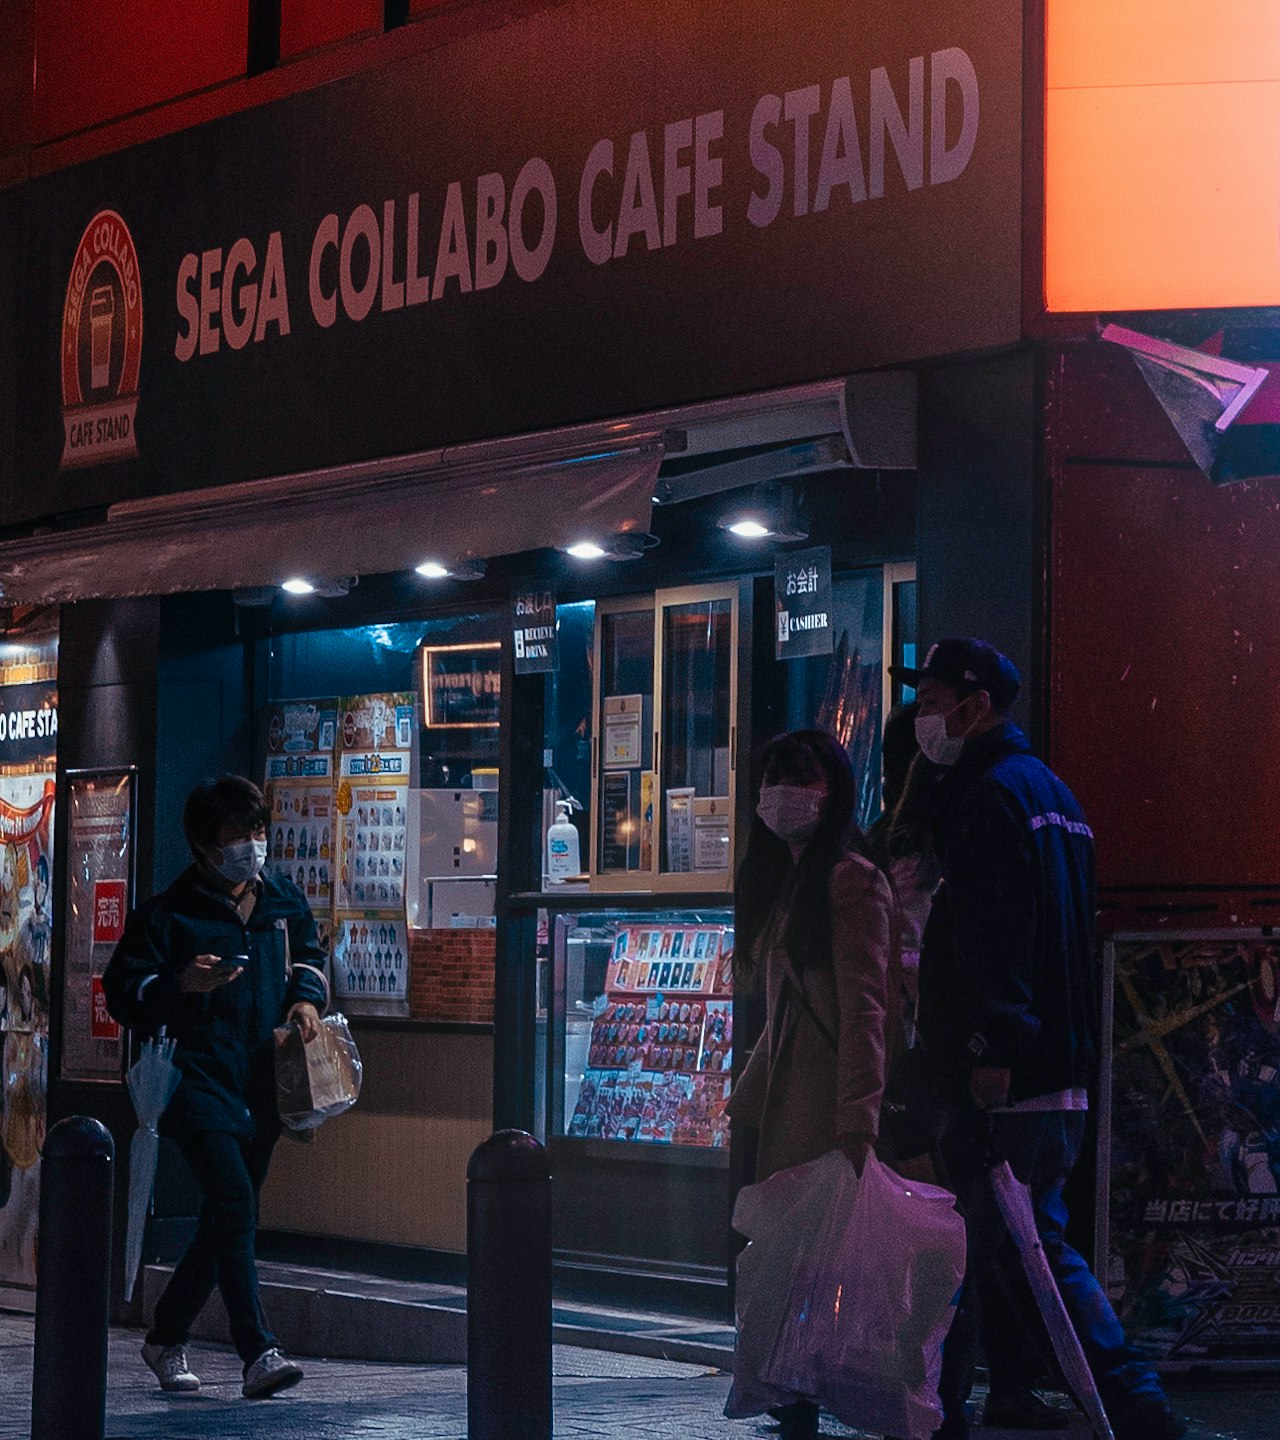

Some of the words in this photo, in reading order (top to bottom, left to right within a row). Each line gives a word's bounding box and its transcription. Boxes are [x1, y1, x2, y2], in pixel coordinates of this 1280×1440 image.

[174, 231, 291, 363] SEGA
[308, 156, 557, 328] COLLABO
[578, 109, 725, 267] CAFE
[747, 46, 980, 228] STAND
[70, 422, 94, 449] CAFE
[96, 414, 130, 442] STAND
[786, 570, 819, 596] お会計
[789, 613, 828, 633] CASHIER
[9, 713, 36, 741] CAFE
